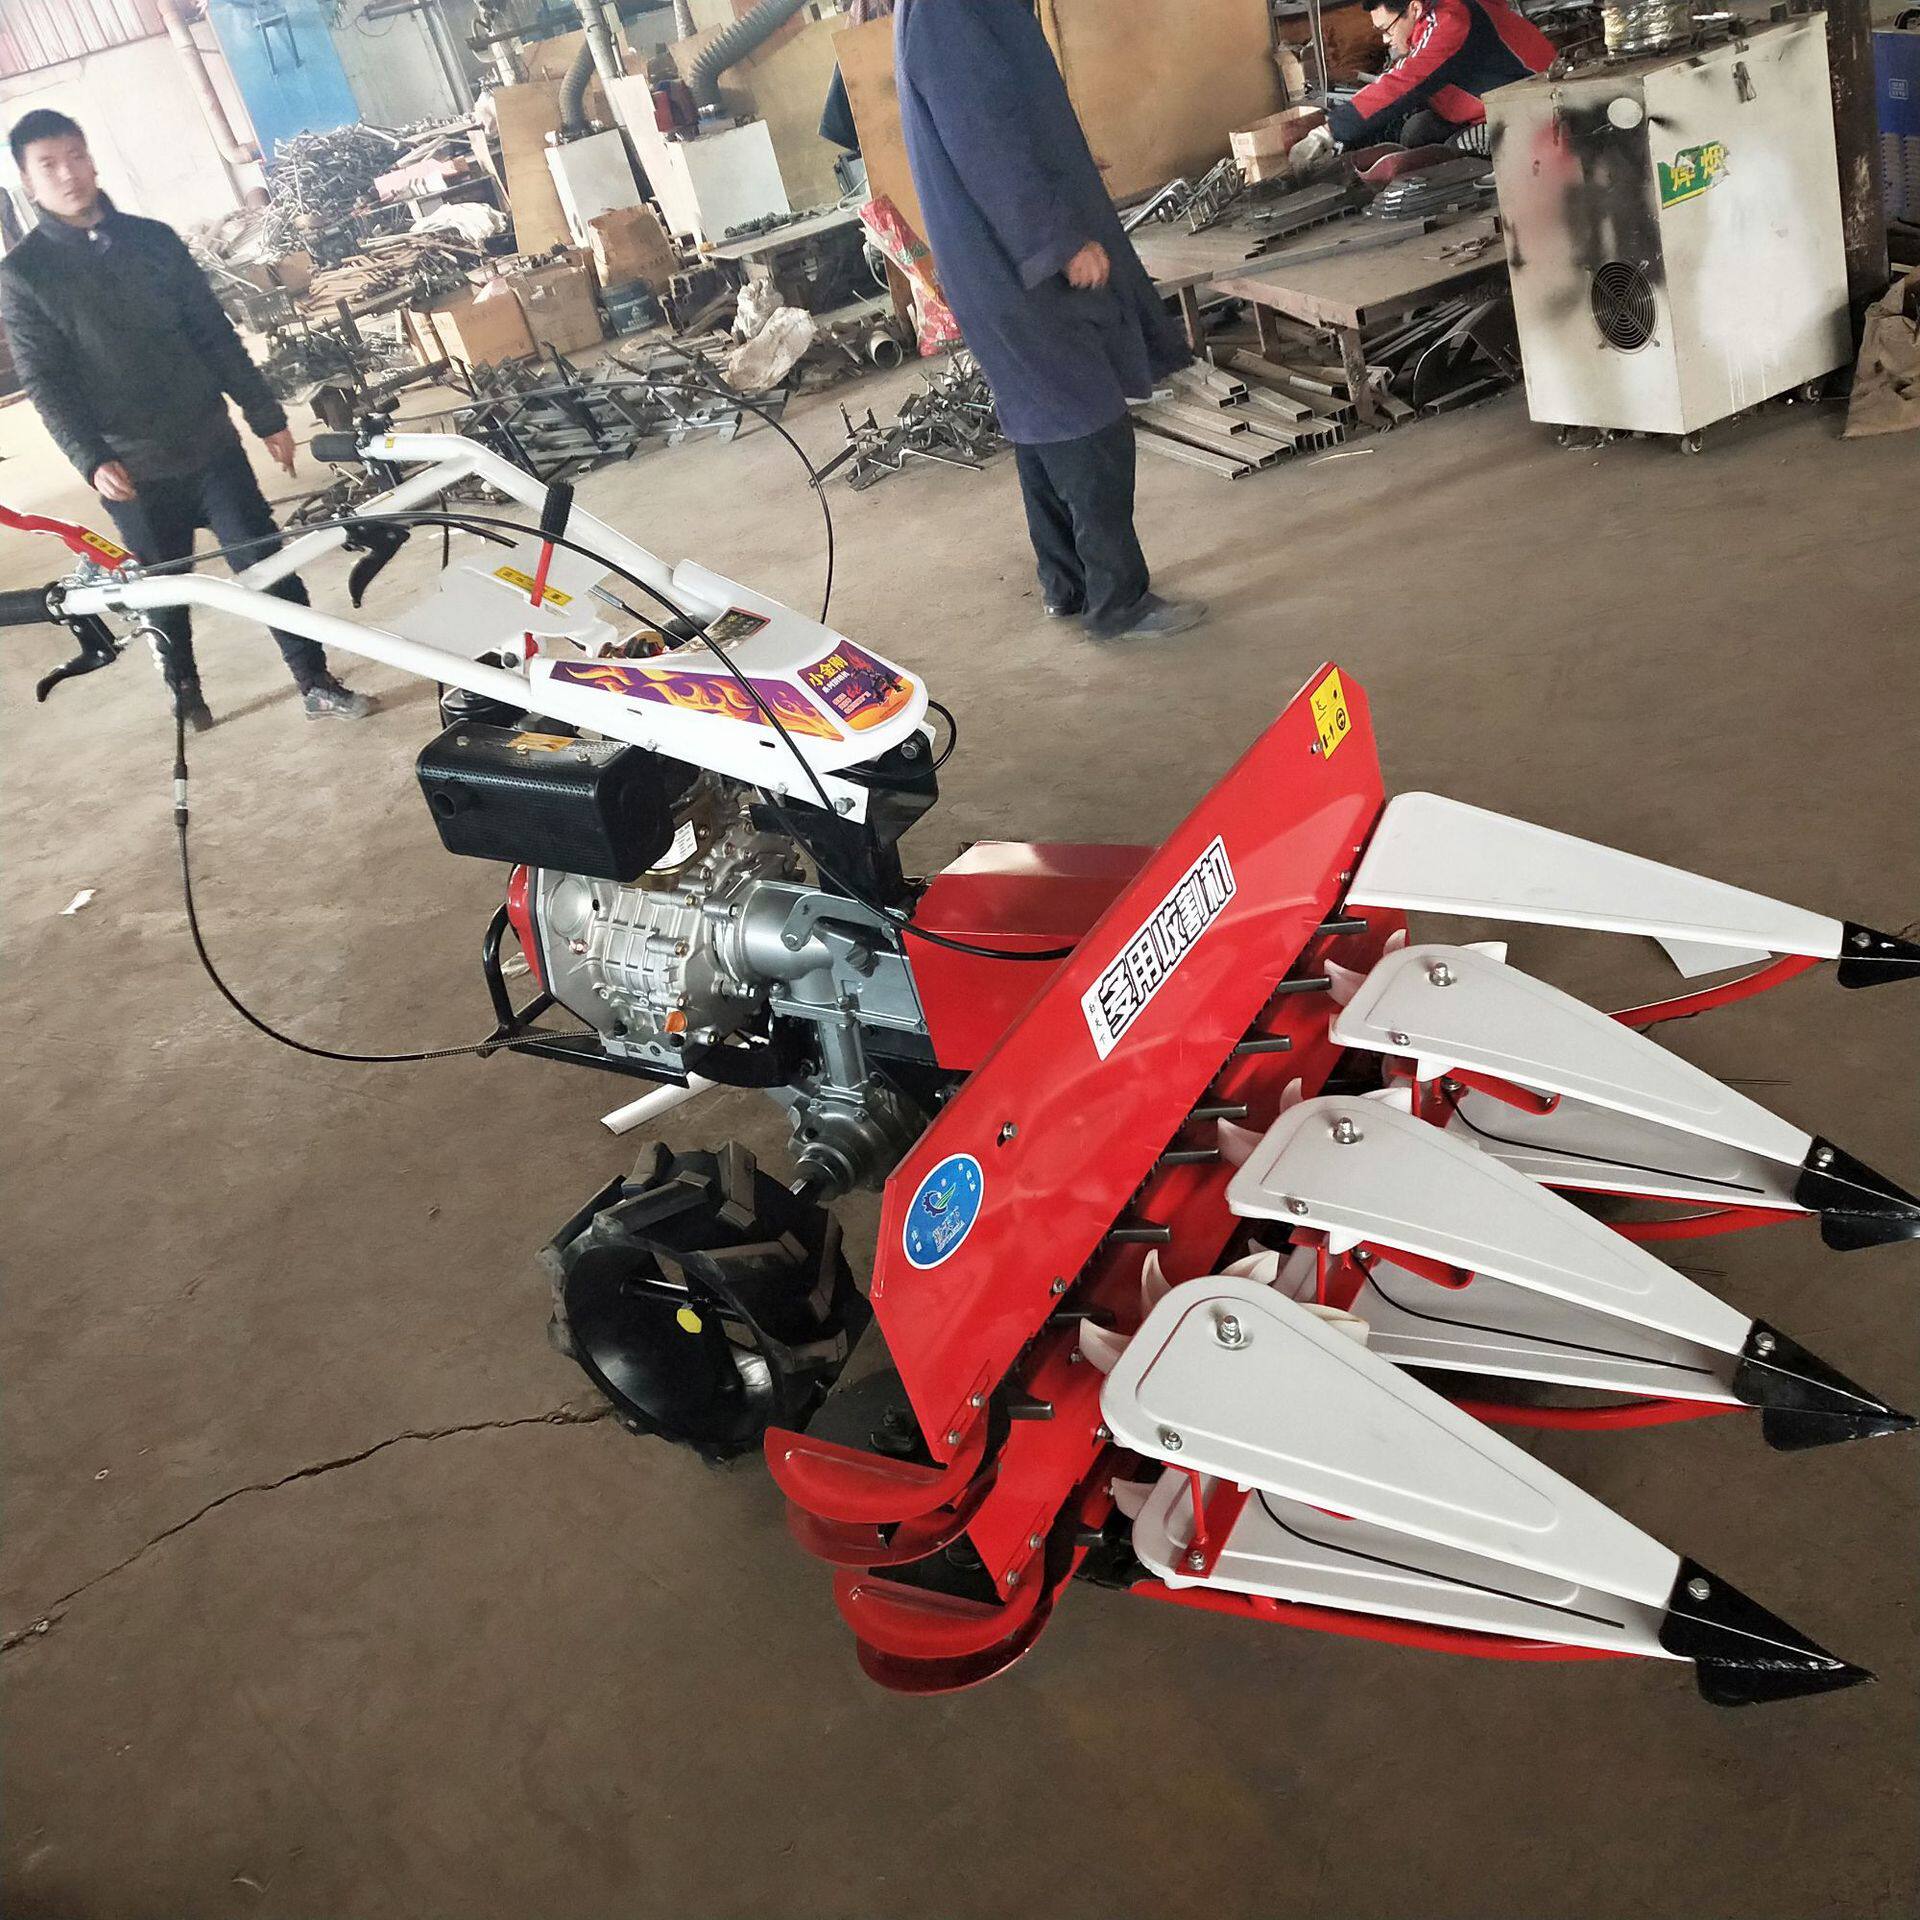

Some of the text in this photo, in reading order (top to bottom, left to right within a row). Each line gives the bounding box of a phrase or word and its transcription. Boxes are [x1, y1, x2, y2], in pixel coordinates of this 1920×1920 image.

[1098, 842, 1234, 1039] 多用收割机
